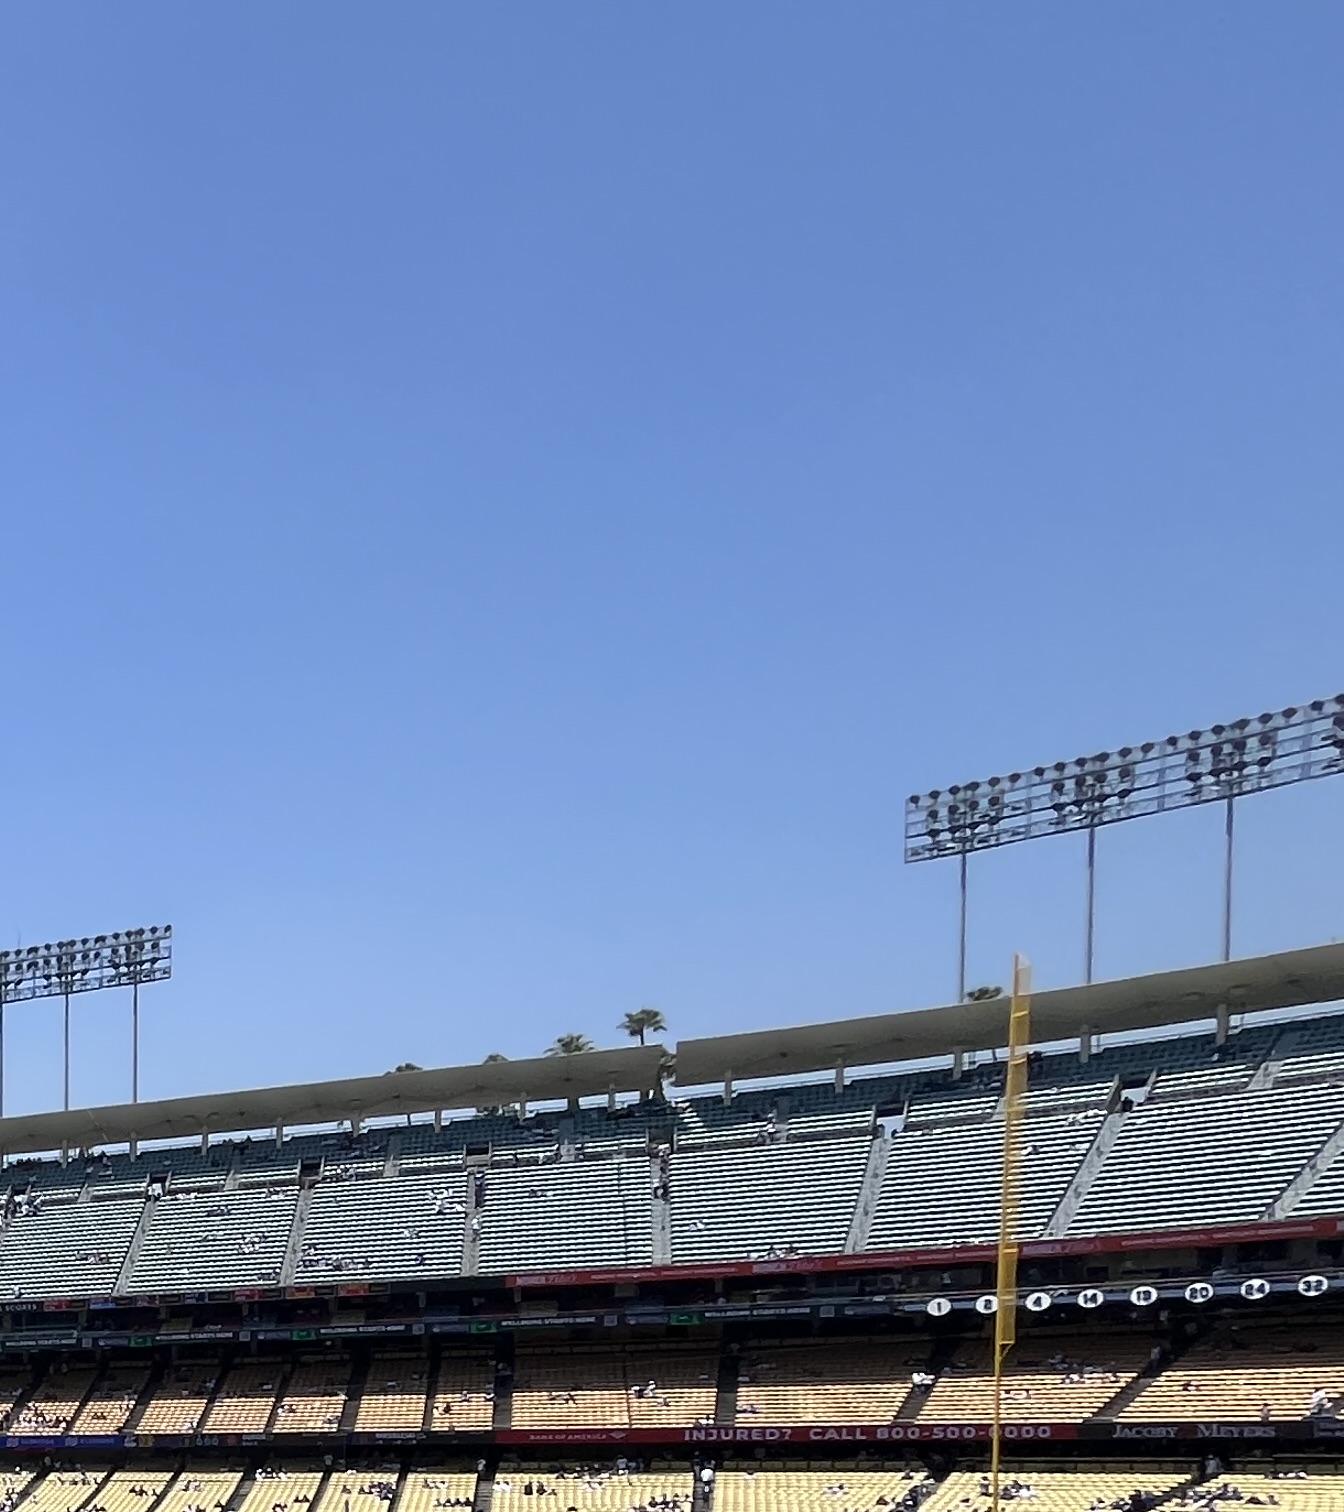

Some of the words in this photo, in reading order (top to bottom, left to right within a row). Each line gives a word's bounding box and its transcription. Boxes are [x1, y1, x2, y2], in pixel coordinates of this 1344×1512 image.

[1302, 1279, 1324, 1293] 32
[684, 1428, 792, 1441] INJURED?
[809, 1427, 867, 1440] CALL
